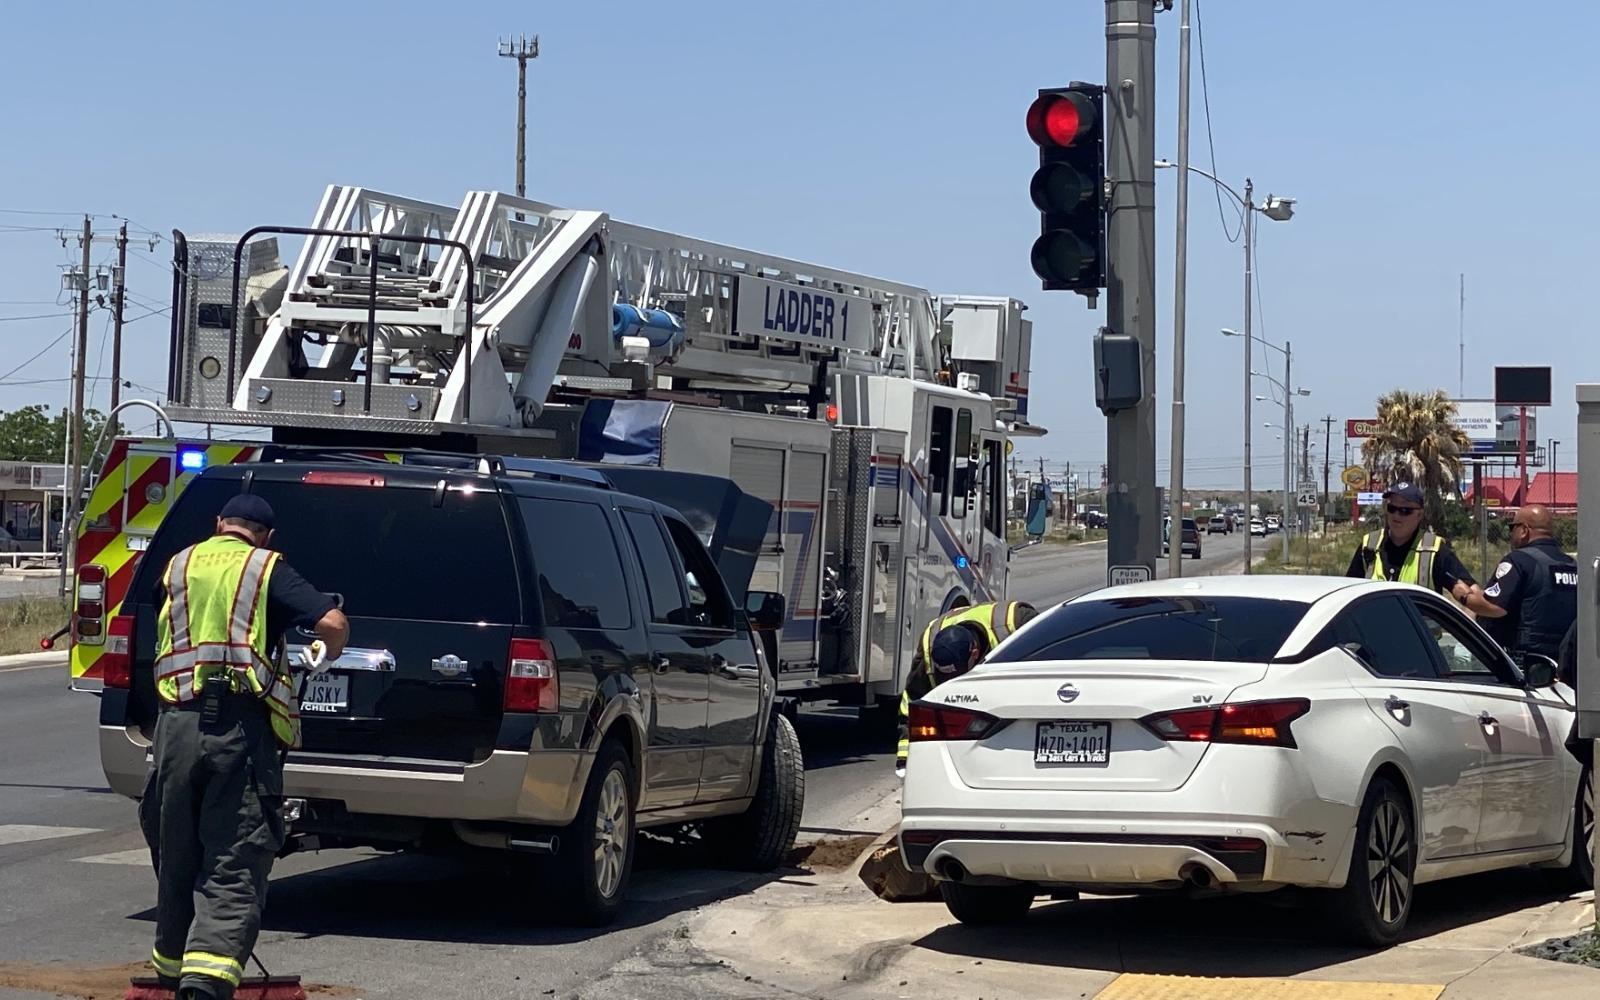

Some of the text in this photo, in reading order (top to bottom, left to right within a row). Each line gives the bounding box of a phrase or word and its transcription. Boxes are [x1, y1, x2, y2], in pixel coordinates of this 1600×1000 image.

[764, 286, 848, 342] LADDER 1
[1299, 494, 1316, 504] 45
[1555, 572, 1578, 585] POLI
[309, 686, 341, 704] JSKY
[944, 695, 979, 703] ALTIMA
[1193, 695, 1213, 703] SV
[1060, 724, 1088, 733] TEXAS
[1064, 753, 1078, 763] Cars
